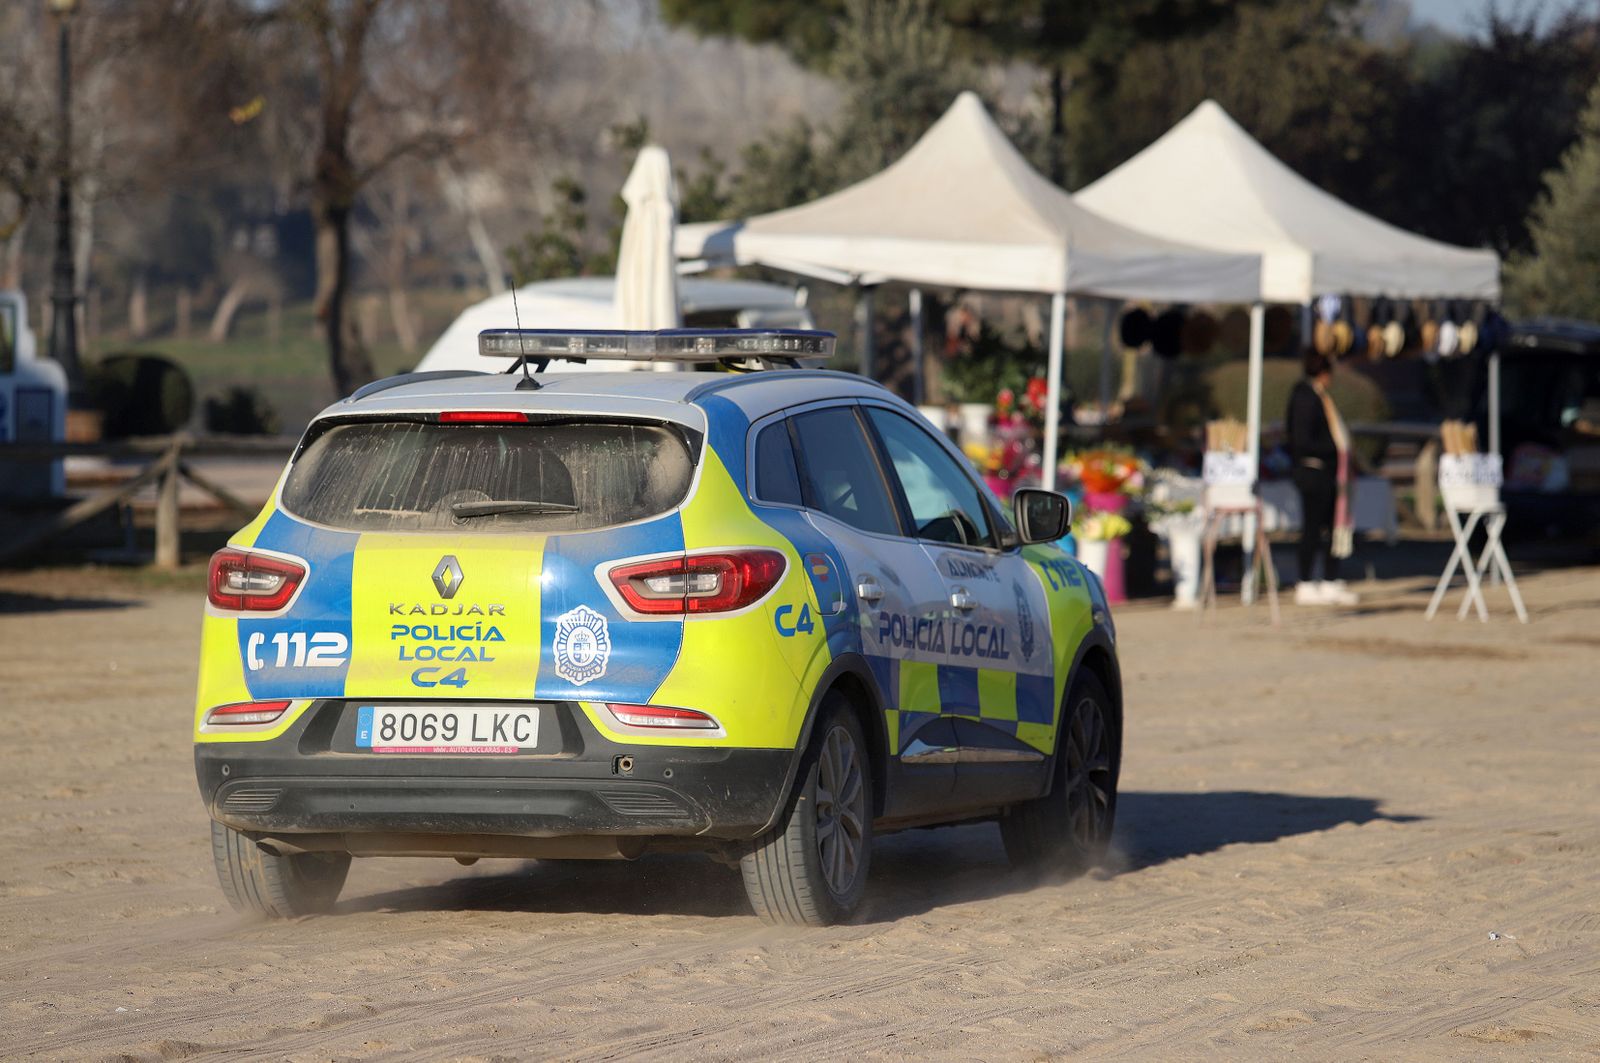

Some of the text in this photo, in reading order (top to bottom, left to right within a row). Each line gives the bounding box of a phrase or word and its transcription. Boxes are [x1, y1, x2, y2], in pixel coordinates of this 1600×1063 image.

[389, 603, 506, 616] KADJAR
[774, 602, 815, 637] C4
[390, 621, 506, 642] POLICÍA
[950, 621, 1011, 661] LOCAL
[398, 645, 496, 662] LOCAL
[411, 667, 470, 689] C4
[360, 713, 531, 742] E 8069 LKC
